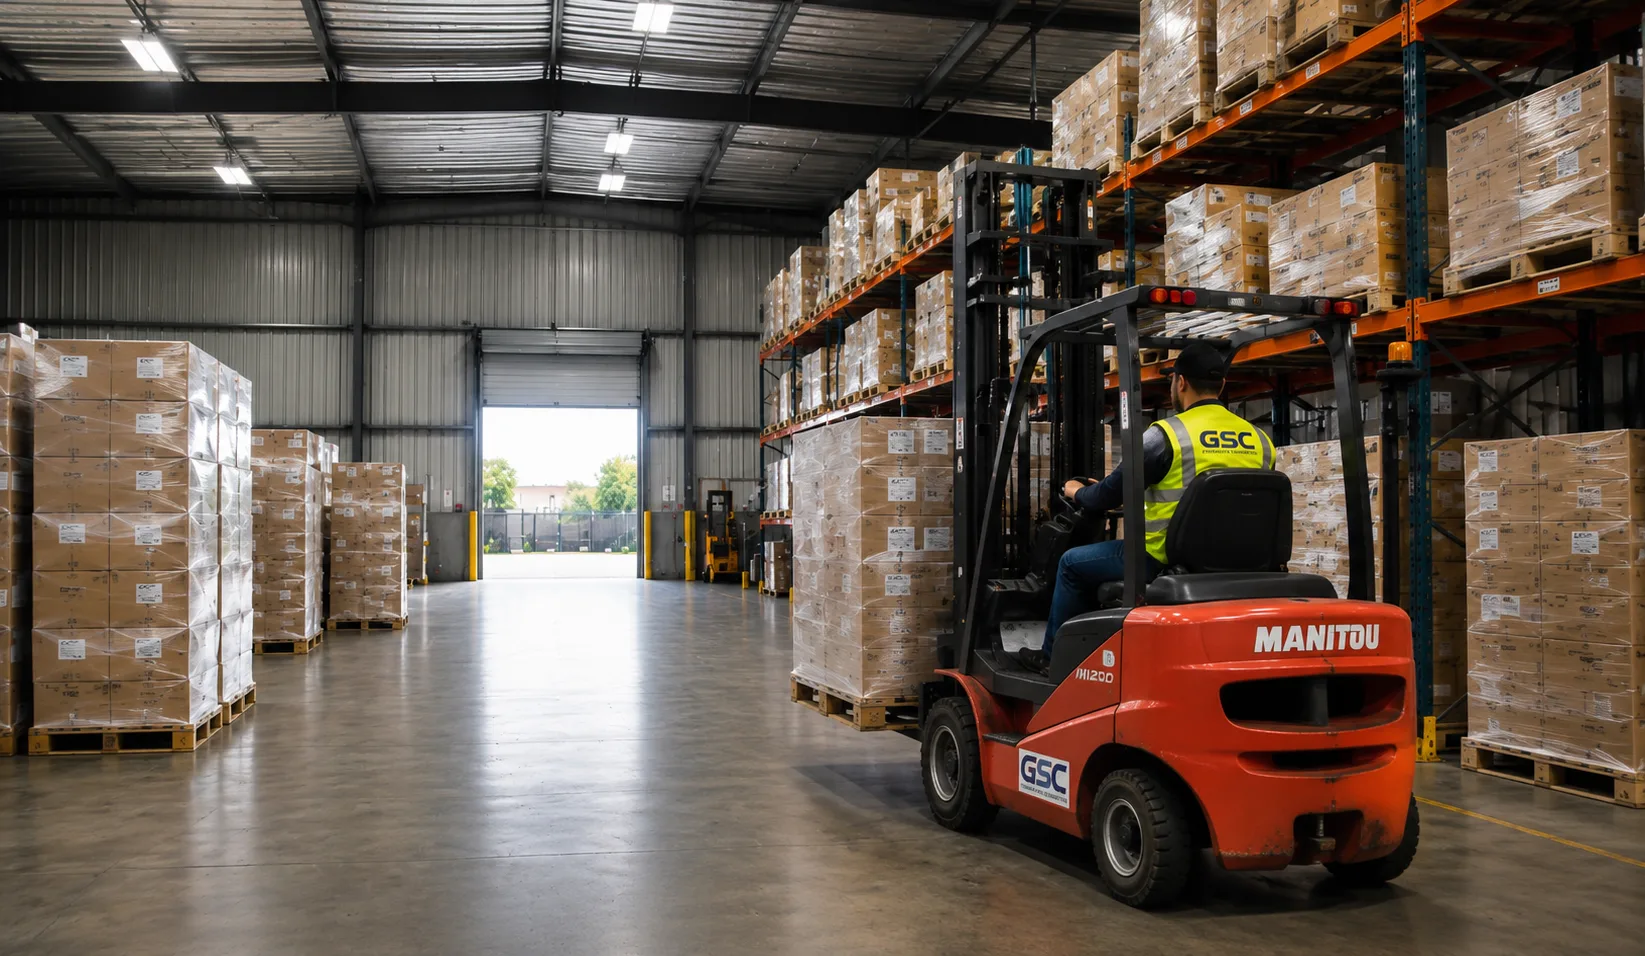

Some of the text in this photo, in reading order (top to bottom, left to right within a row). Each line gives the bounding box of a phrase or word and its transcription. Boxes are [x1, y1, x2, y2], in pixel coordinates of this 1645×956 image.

[1200, 430, 1255, 450] GSC
[1254, 624, 1380, 653] MANITOU
[1020, 754, 1067, 795] GSC
